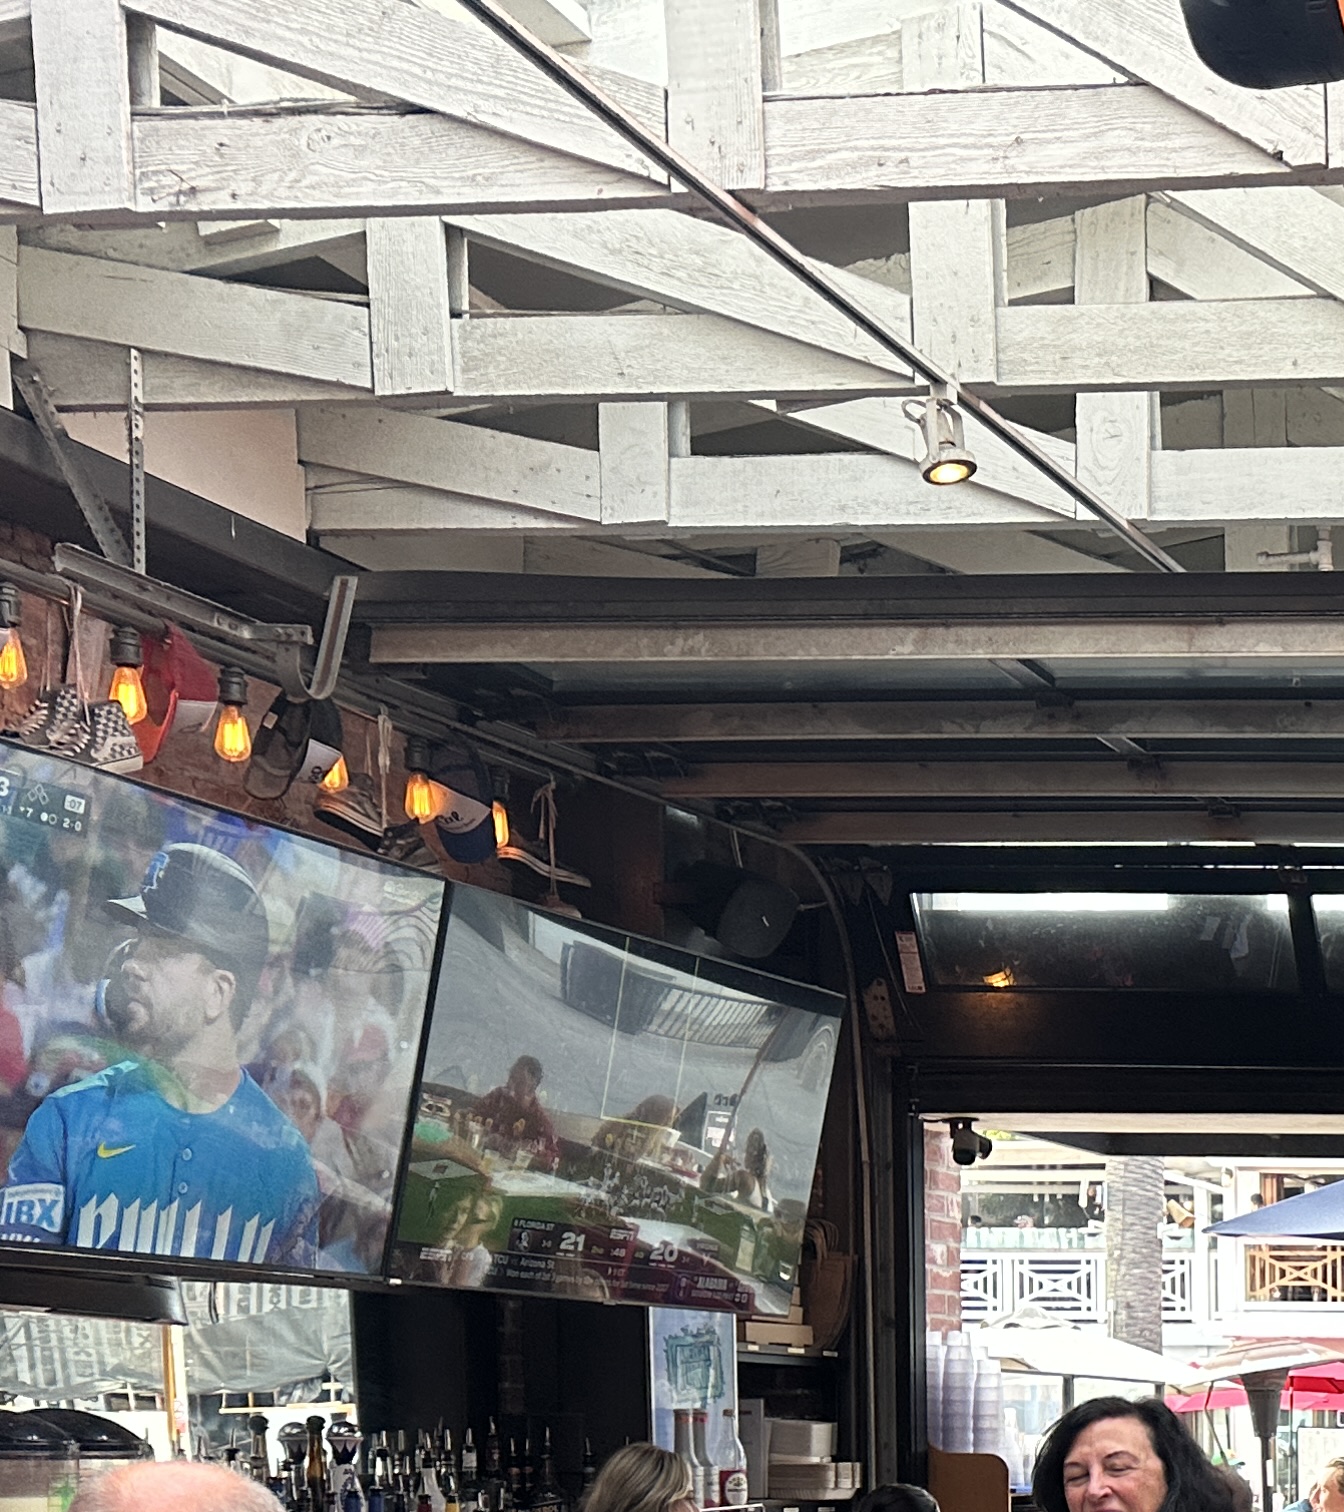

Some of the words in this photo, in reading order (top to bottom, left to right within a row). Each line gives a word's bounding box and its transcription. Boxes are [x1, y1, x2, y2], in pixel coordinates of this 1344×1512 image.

[559, 1231, 586, 1252] 21
[494, 1254, 509, 1265] TCU
[650, 1244, 678, 1262] 20
